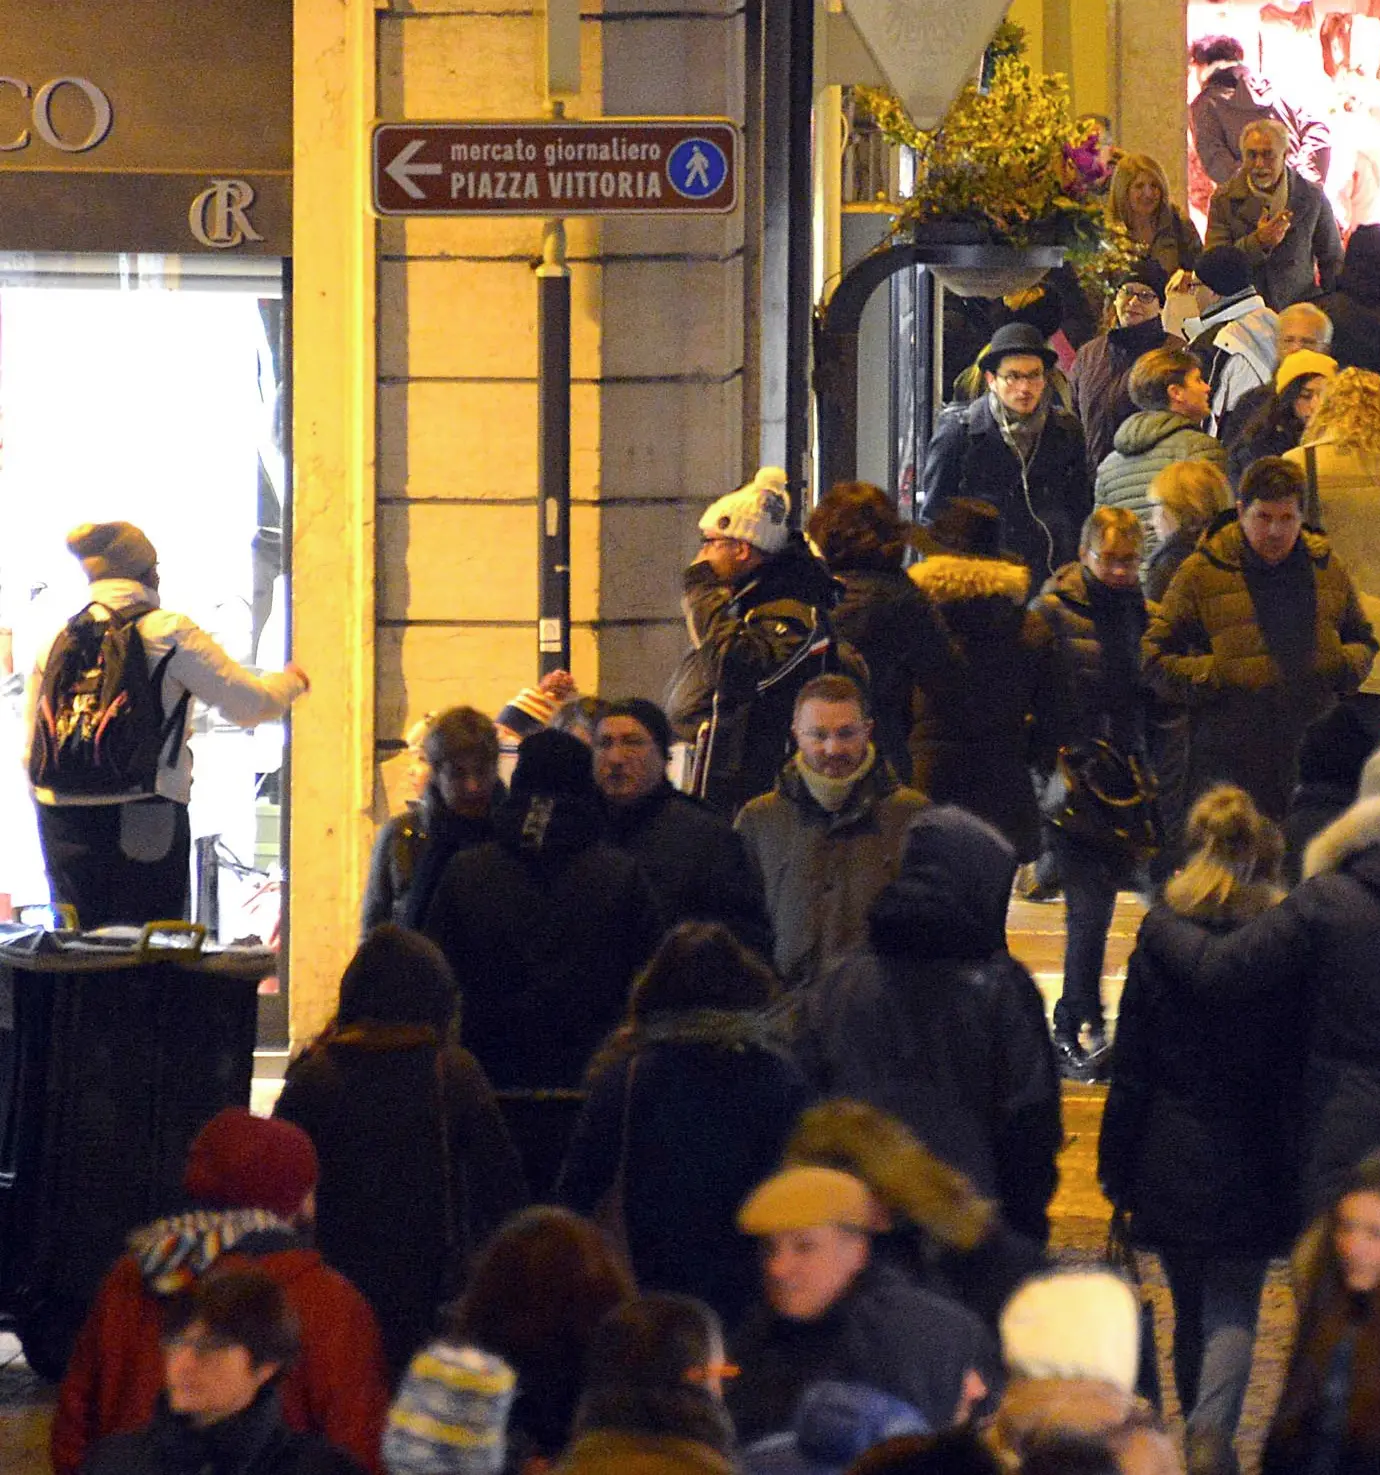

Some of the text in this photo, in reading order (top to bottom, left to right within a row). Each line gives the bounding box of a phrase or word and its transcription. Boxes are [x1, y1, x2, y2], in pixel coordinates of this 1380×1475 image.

[451, 137, 661, 167] mercato giornaliero
[451, 171, 662, 199] PIAZZA VITTORIA
